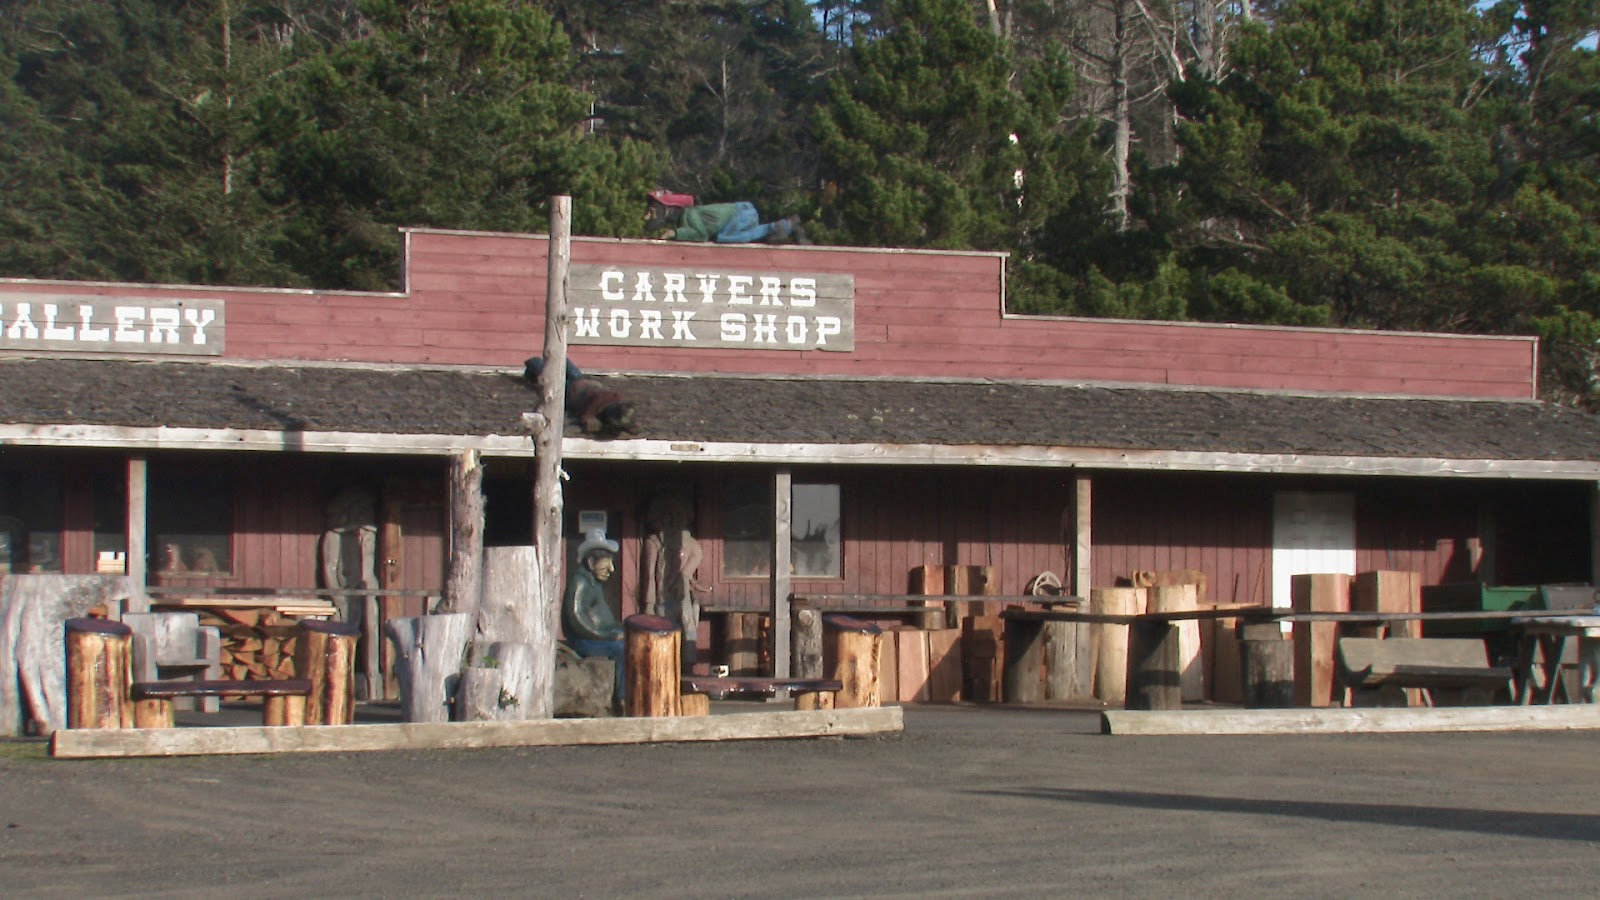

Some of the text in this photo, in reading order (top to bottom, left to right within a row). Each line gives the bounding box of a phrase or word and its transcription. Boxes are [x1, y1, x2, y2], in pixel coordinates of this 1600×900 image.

[599, 271, 816, 307] CARVERS
[0, 302, 215, 344] ALLERY
[574, 307, 841, 345] WORK SHOP
